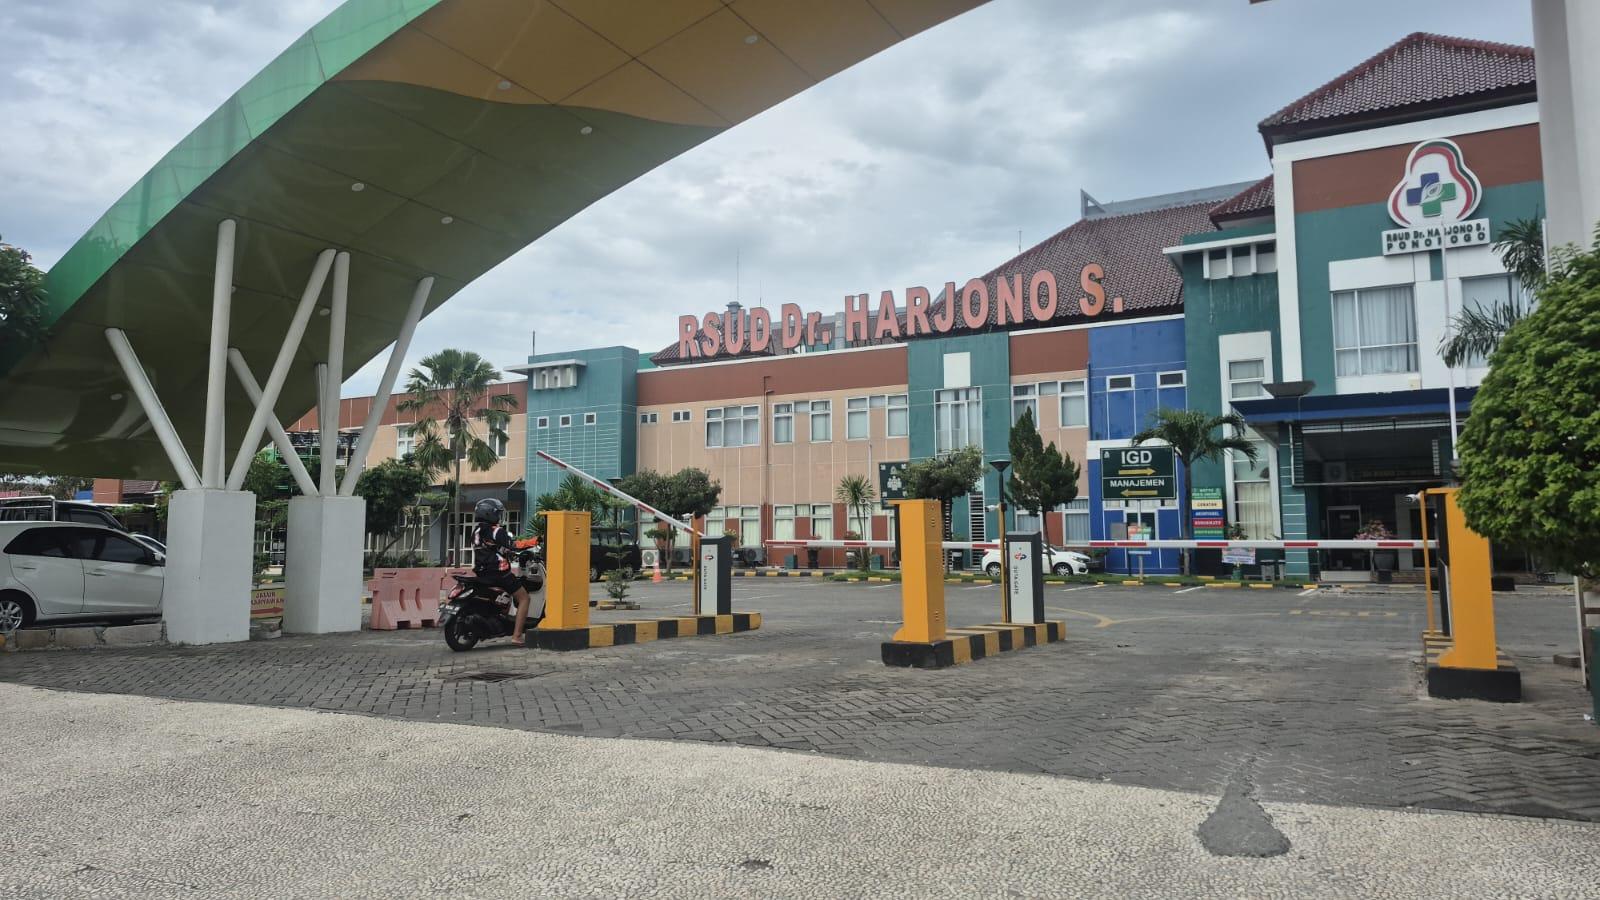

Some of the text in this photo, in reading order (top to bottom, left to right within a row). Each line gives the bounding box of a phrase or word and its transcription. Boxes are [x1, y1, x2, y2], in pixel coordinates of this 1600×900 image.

[679, 262, 1124, 359] RSUD Dr. HARJONO S.
[1121, 450, 1153, 465] IGD
[1109, 479, 1165, 488] MANAJEMEN
